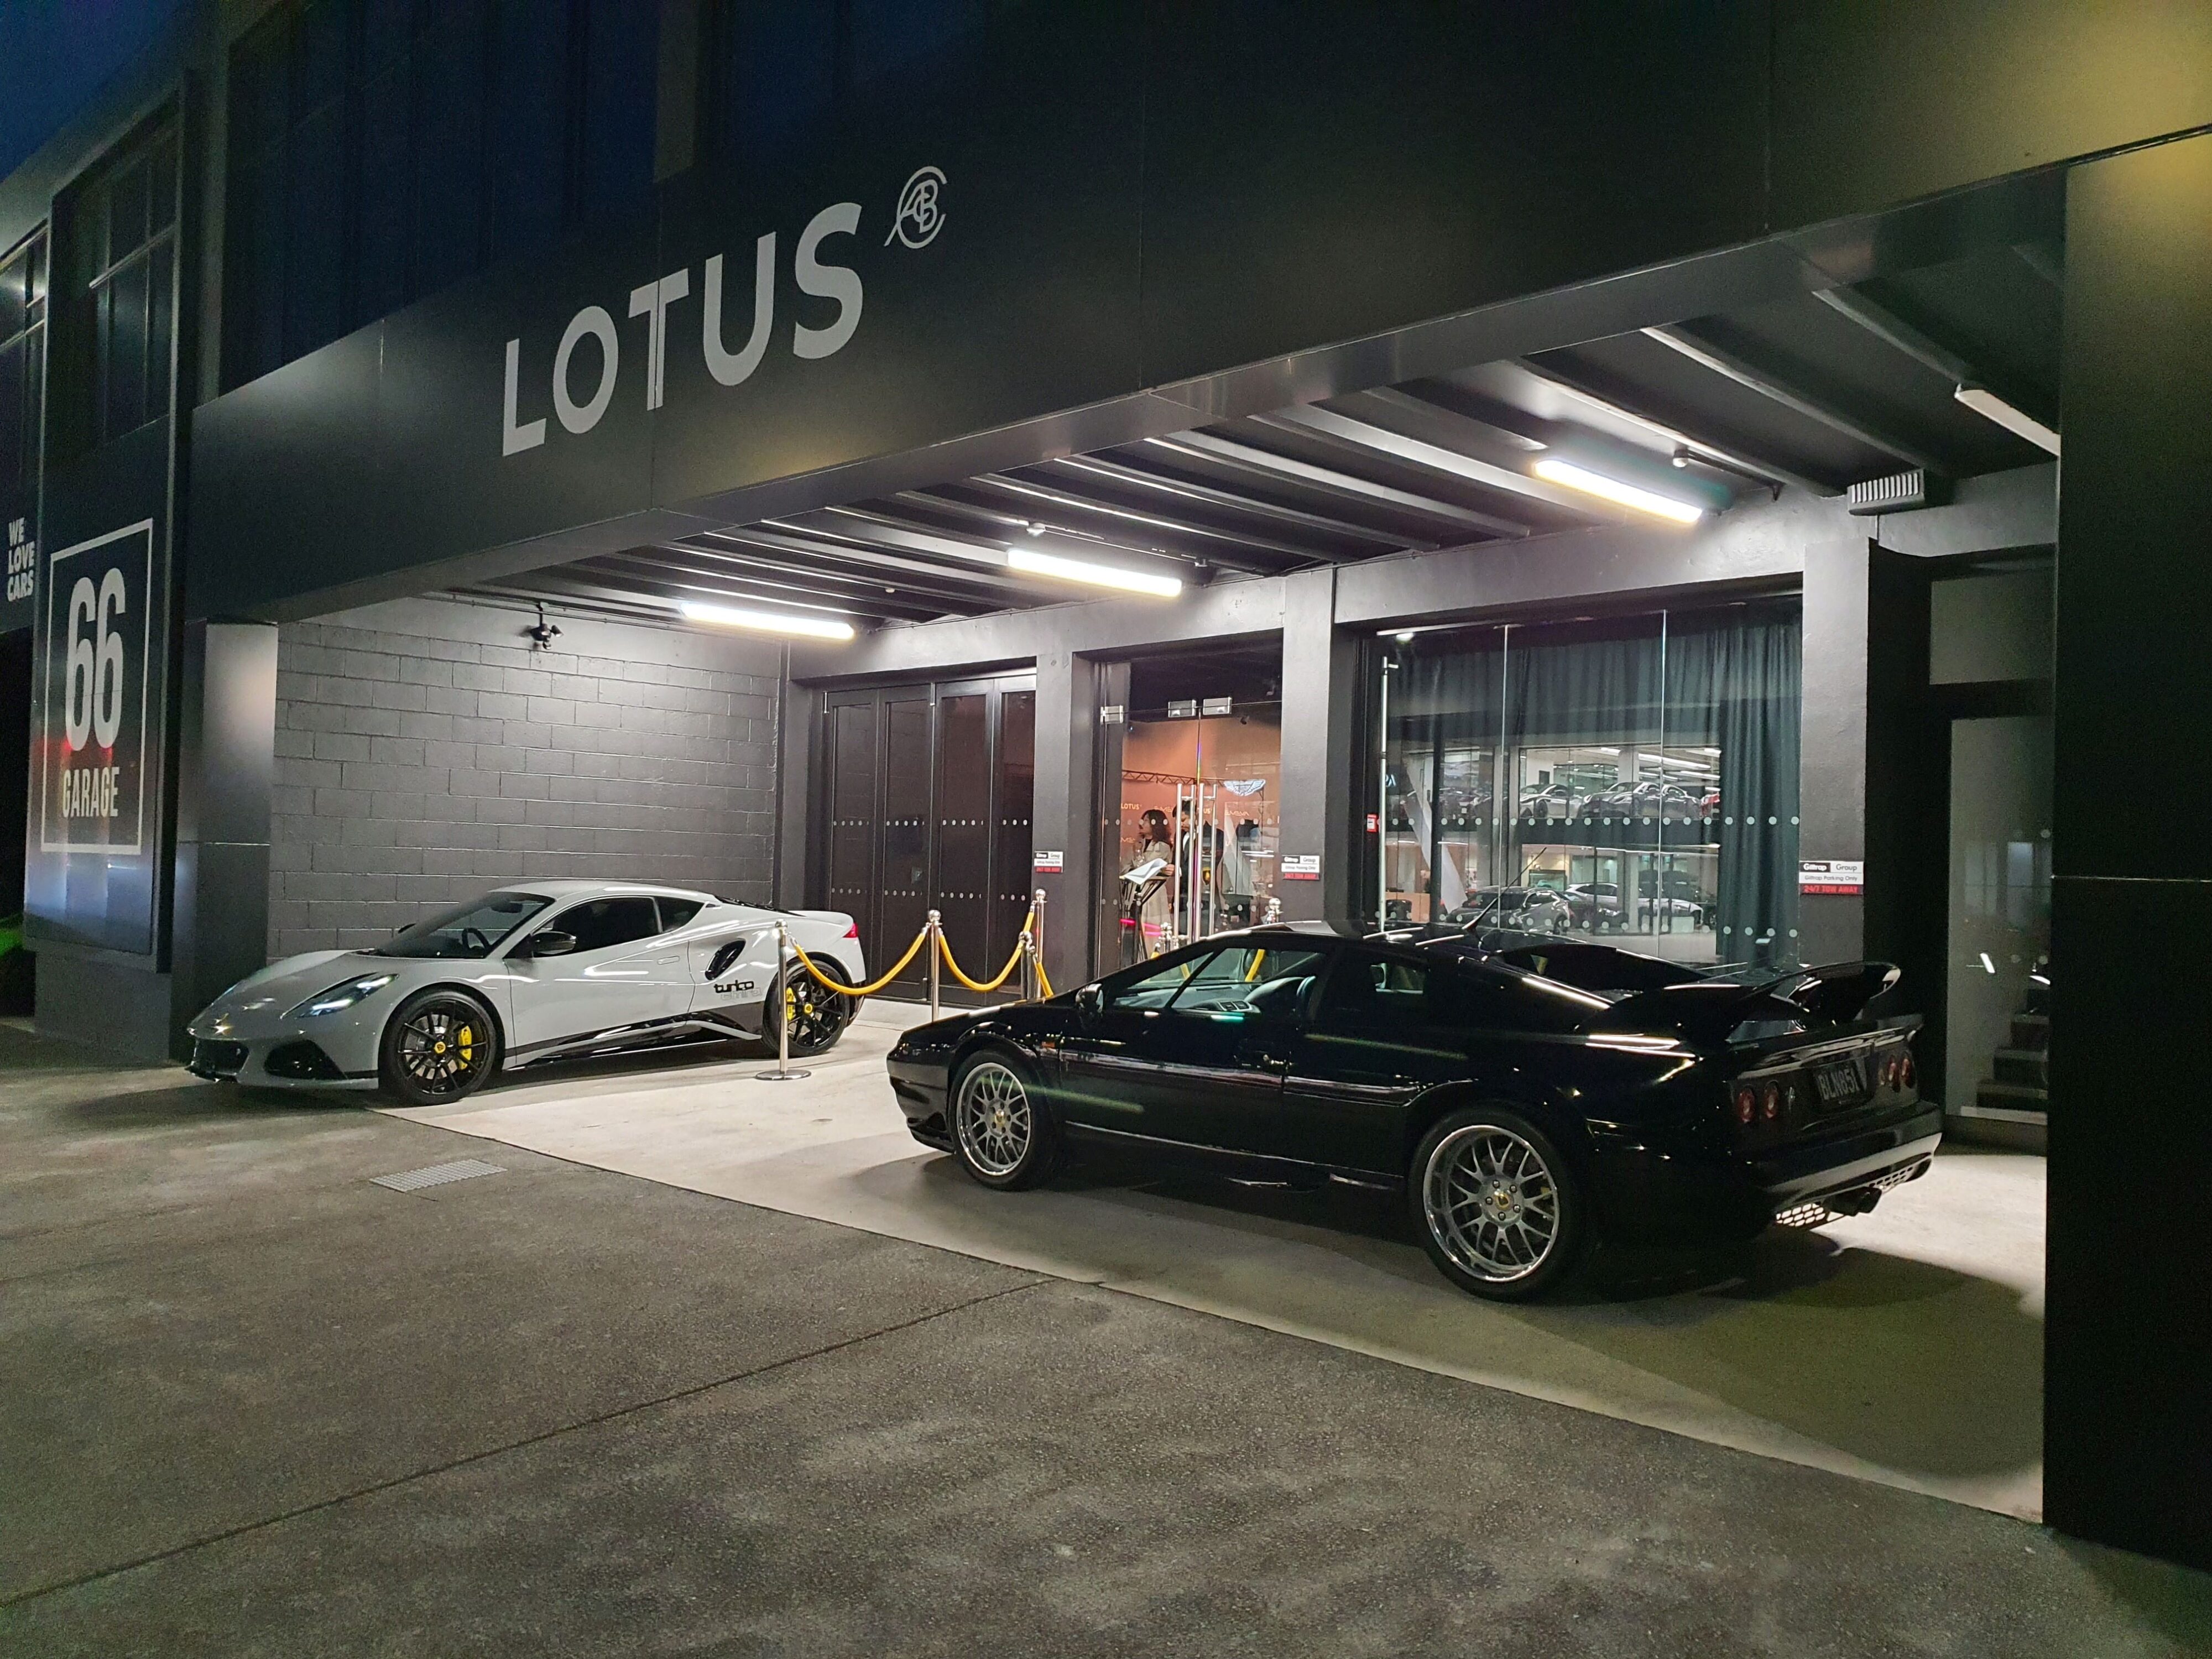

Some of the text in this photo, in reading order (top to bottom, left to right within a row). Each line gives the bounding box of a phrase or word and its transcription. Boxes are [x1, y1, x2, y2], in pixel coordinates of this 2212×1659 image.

[502, 202, 863, 456] LOTUS
[9, 517, 25, 546] WE
[8, 541, 35, 574] LOVE
[7, 570, 34, 602] CARS
[65, 568, 126, 751] 66
[62, 766, 120, 817] GARAGE
[1836, 864, 1858, 872] Group
[713, 980, 754, 993] turbo
